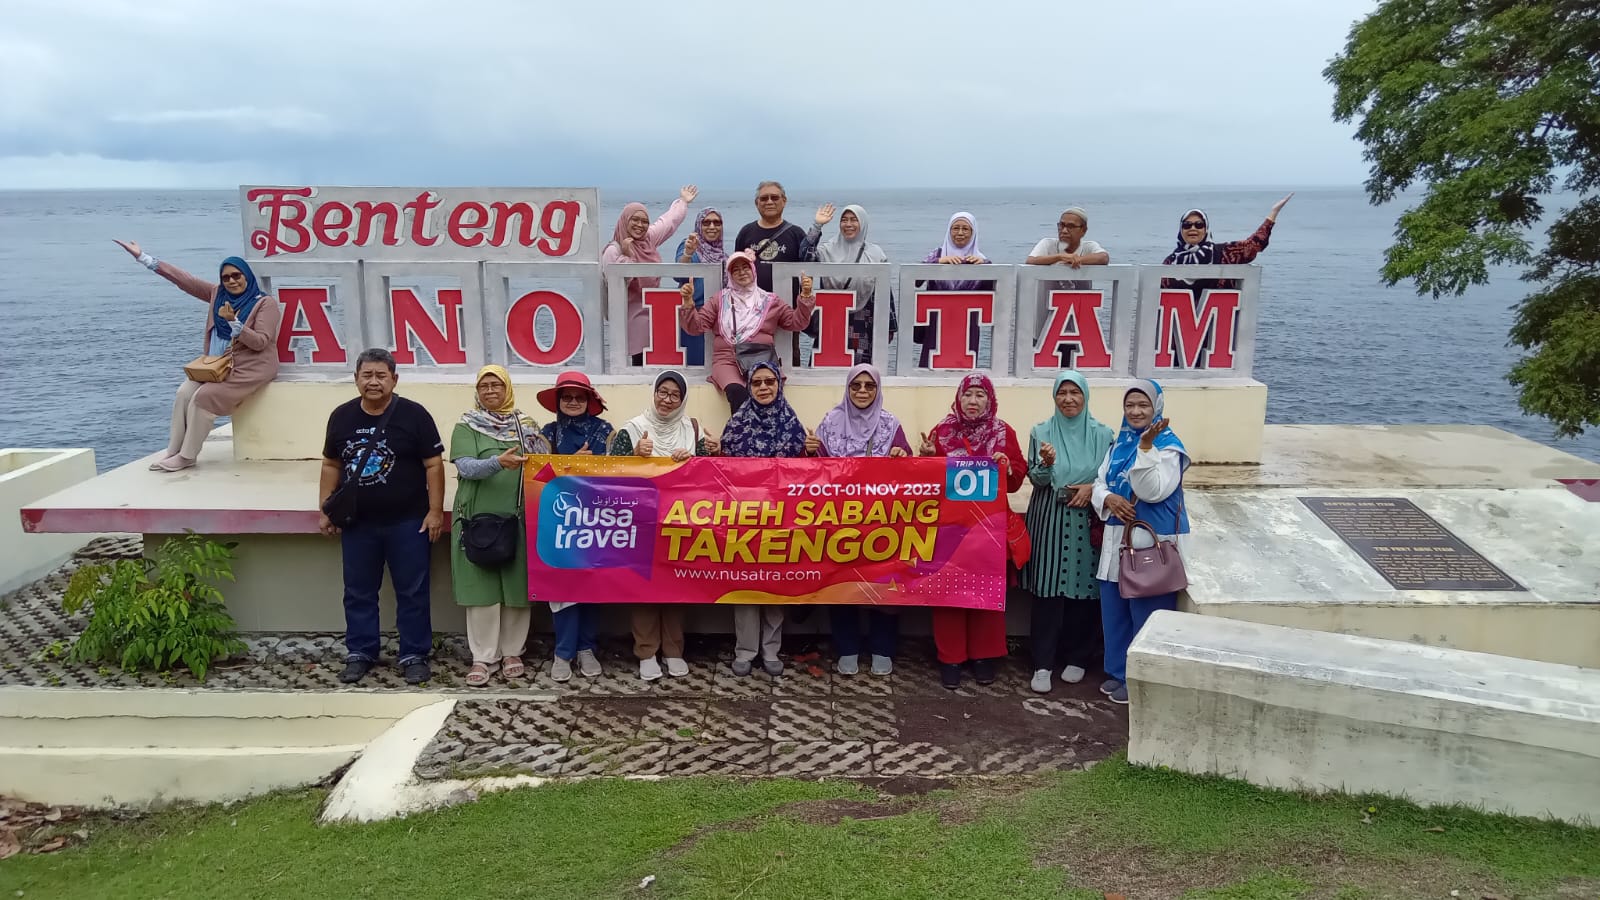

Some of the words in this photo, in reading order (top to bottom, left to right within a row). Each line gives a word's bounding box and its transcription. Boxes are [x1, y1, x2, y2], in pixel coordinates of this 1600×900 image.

[246, 187, 586, 257] Benteng
[276, 286, 687, 367] ANOI
[811, 288, 1242, 370] ITAM
[787, 484, 805, 496] 27
[808, 484, 861, 496] OCT-01
[865, 484, 900, 496] NOV
[903, 483, 941, 496] 2023
[953, 469, 991, 496] 01
[563, 507, 634, 527] nusa
[662, 500, 785, 526] ACHEH
[793, 499, 940, 526] SABANG
[555, 525, 637, 549] travel
[660, 526, 938, 563] TAKENGON
[674, 568, 821, 581] www.nusatra.com
